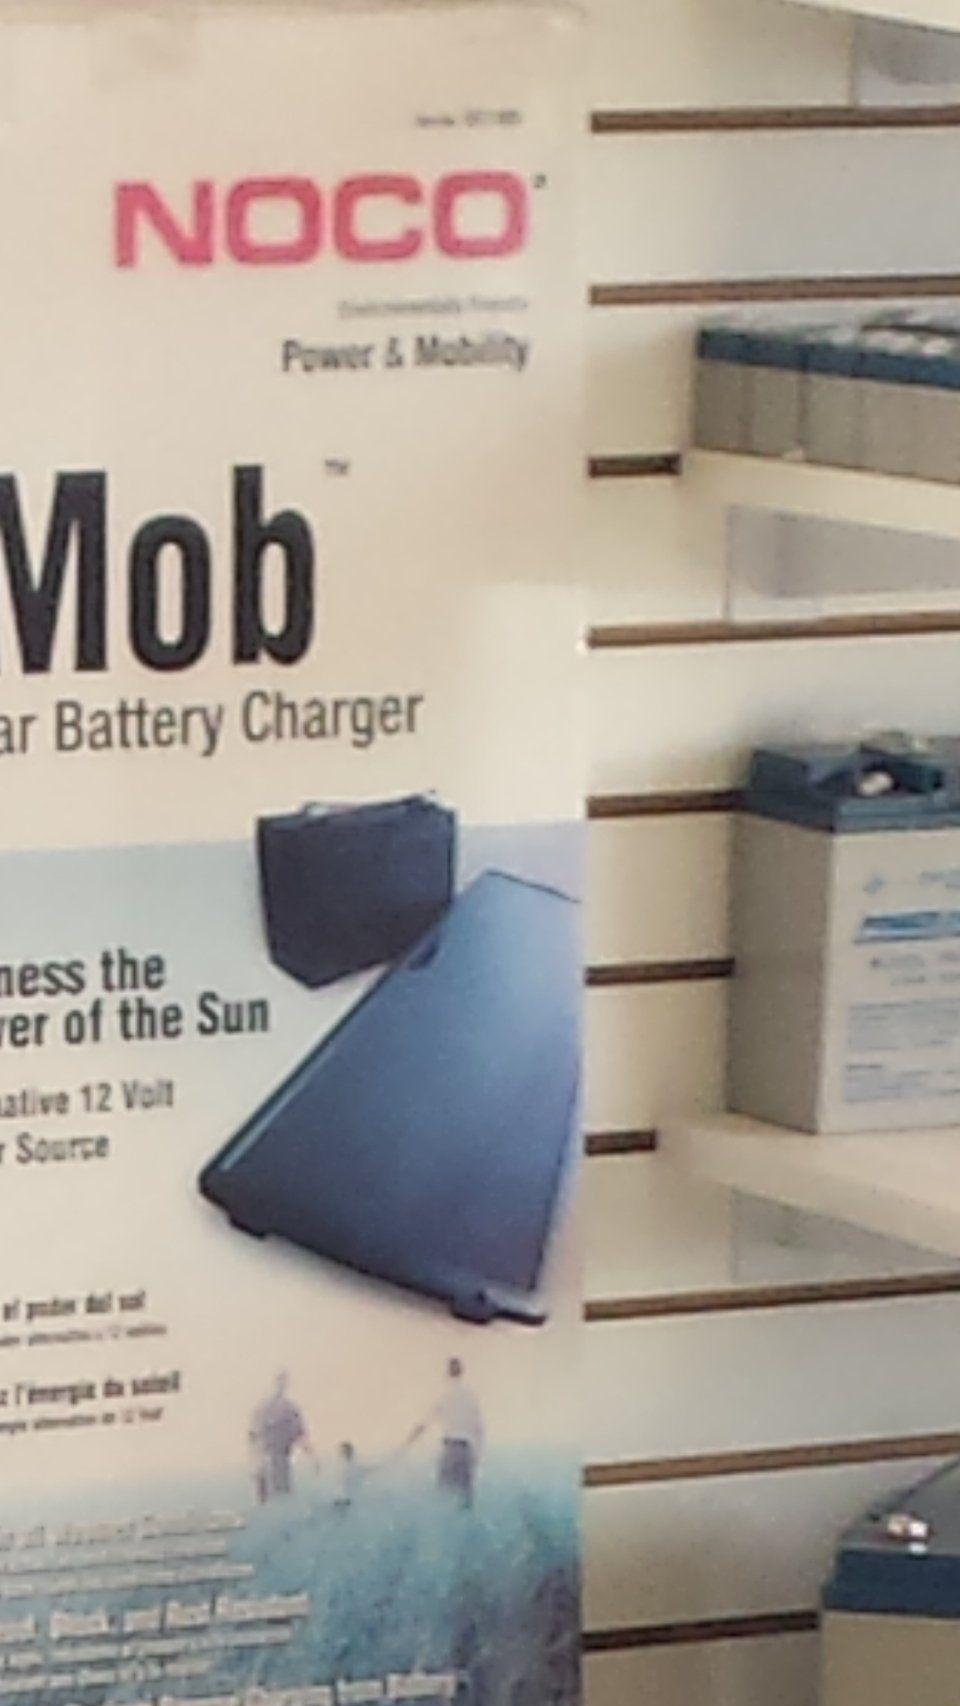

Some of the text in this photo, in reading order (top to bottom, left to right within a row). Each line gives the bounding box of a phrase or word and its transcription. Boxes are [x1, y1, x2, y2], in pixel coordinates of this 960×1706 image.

[114, 169, 529, 268] NOCO
[282, 334, 528, 373] Power & Mobility
[55, 698, 224, 757] Battery
[243, 690, 424, 749] Charger
[100, 948, 165, 993] the
[64, 997, 104, 1045] of
[118, 994, 183, 1041] the
[197, 990, 271, 1035] Sun
[80, 1082, 113, 1112] 12
[121, 1078, 174, 1110] Volt
[15, 1131, 111, 1163] Source
